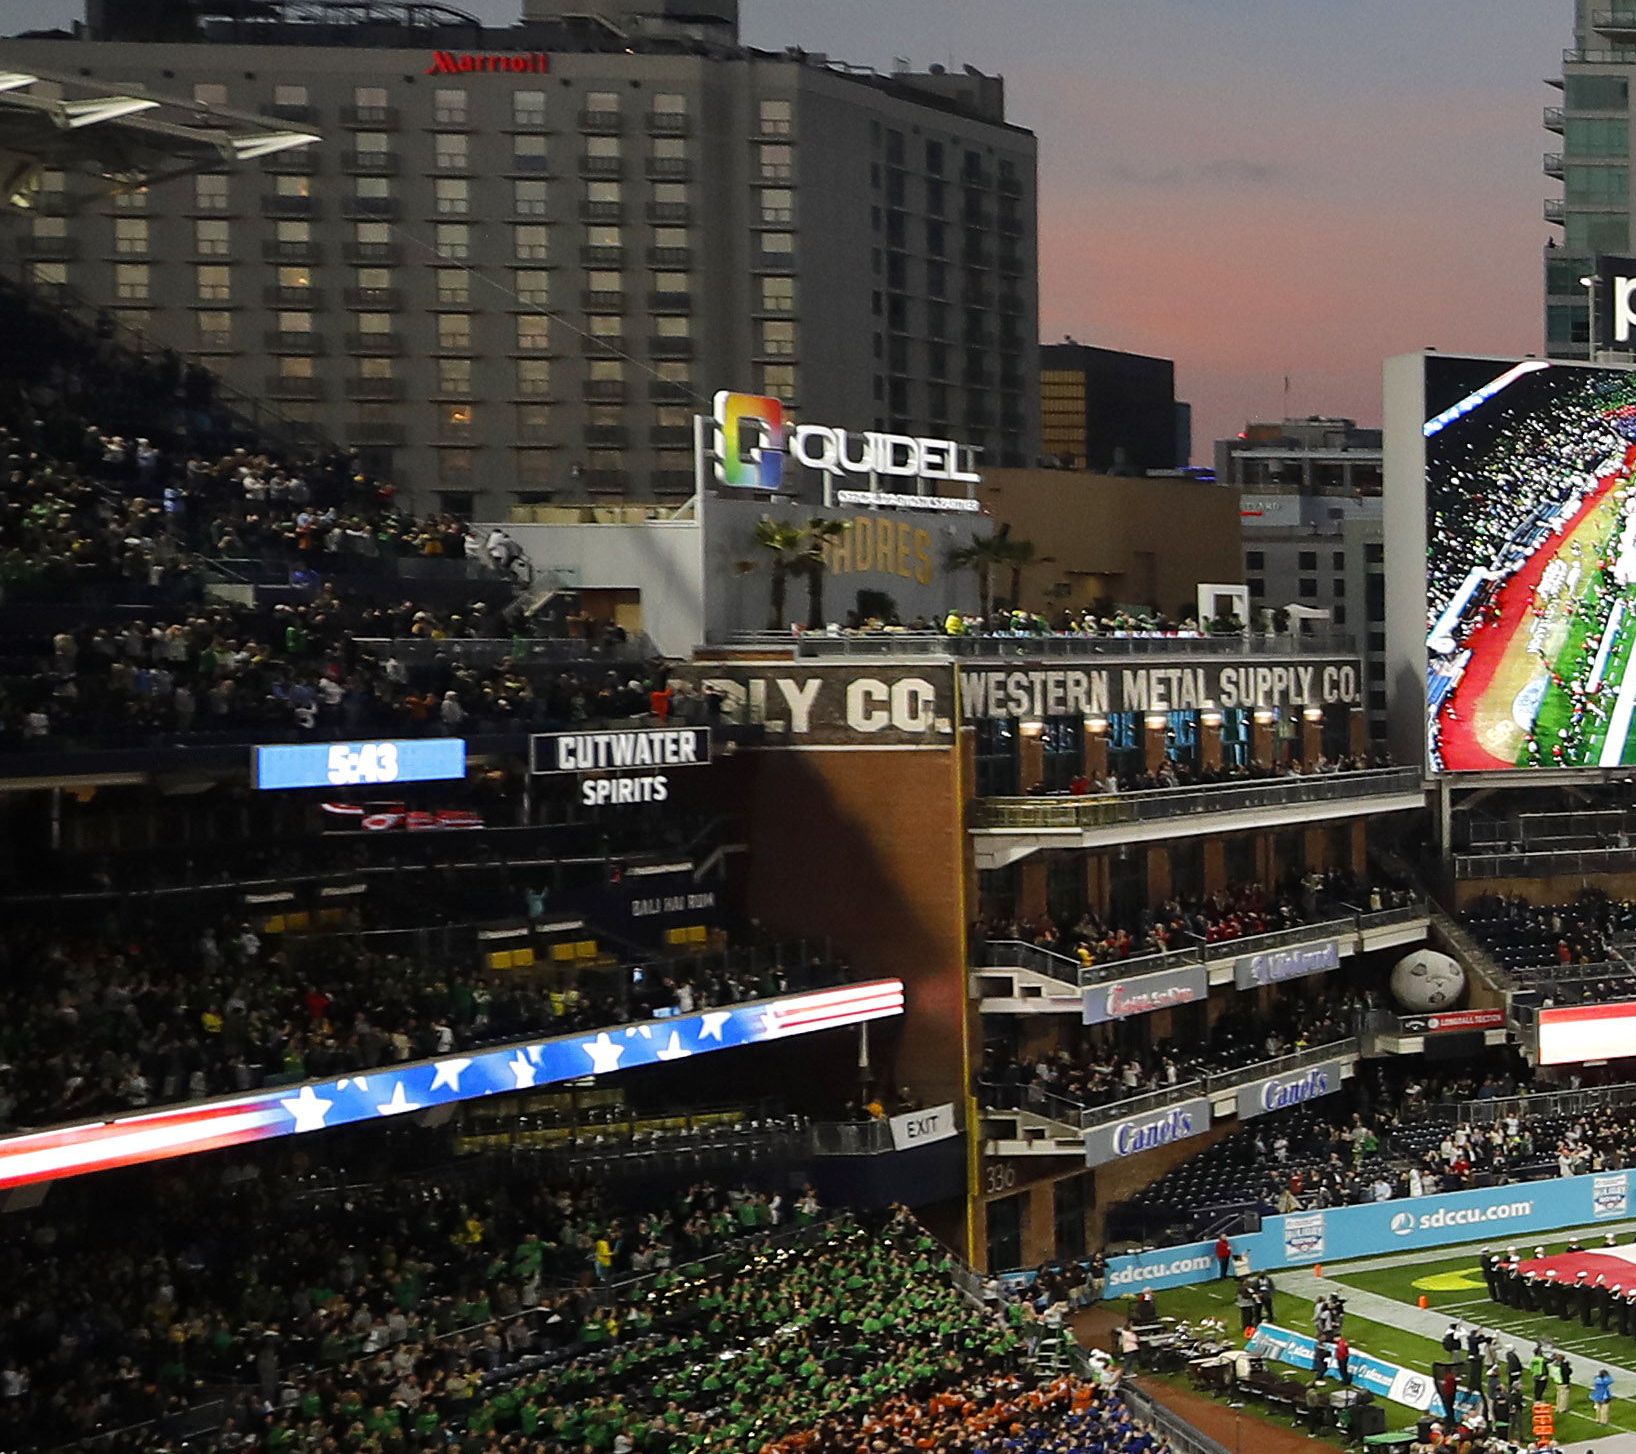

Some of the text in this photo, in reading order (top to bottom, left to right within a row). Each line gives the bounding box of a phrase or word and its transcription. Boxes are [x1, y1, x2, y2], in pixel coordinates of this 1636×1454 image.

[424, 50, 551, 75] Marriott
[790, 423, 982, 483] QUIDEL
[846, 677, 953, 734] CO.
[958, 665, 1362, 719] WESTERN METAL SUPPLY CO.
[327, 742, 399, 785] 5:43
[556, 729, 697, 770] CUTWATER
[581, 775, 669, 807] SPIRITS
[1260, 1067, 1329, 1112] Canel's
[1113, 1106, 1194, 1157] Canel's
[986, 1162, 1016, 1194] 336
[1419, 1200, 1533, 1230] sdccu.com
[1109, 1254, 1212, 1287] sdccu.com
